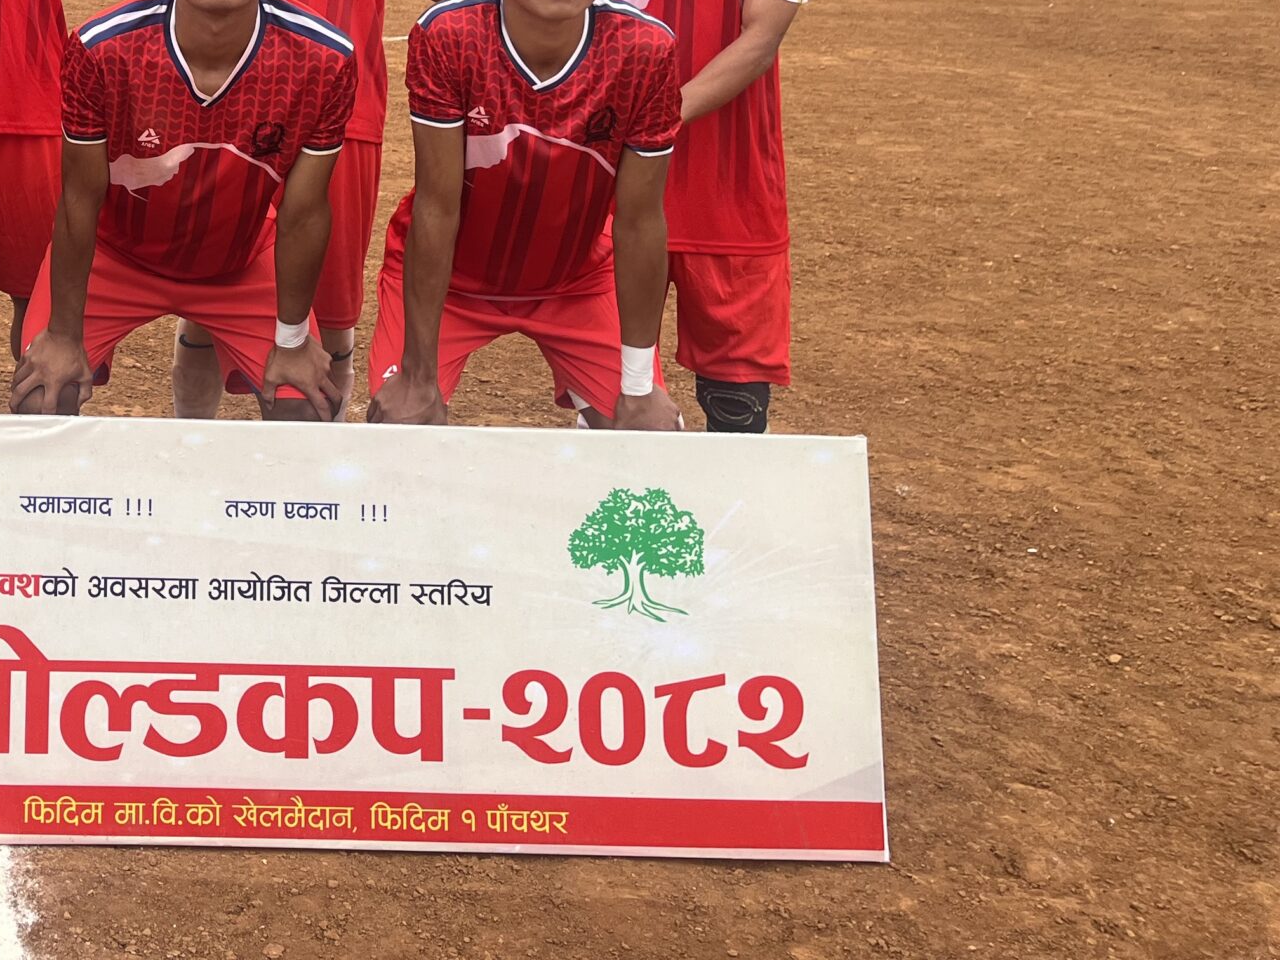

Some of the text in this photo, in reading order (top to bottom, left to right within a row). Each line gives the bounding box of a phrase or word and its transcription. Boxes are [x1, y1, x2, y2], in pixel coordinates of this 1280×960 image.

[19, 495, 113, 516] समाजवाद
[225, 500, 276, 519] तरुण
[283, 502, 340, 520] एकता
[87, 575, 199, 600] अवसरमा
[208, 571, 312, 602] आयोजित
[321, 575, 401, 604] जिल्ला
[409, 578, 493, 607] स्तरिय
[23, 795, 104, 826] फिदिम
[231, 795, 358, 833] खेलमैदान,
[369, 801, 451, 833] फिदिम
[461, 808, 477, 832] १
[486, 803, 569, 834] पाँचथर
